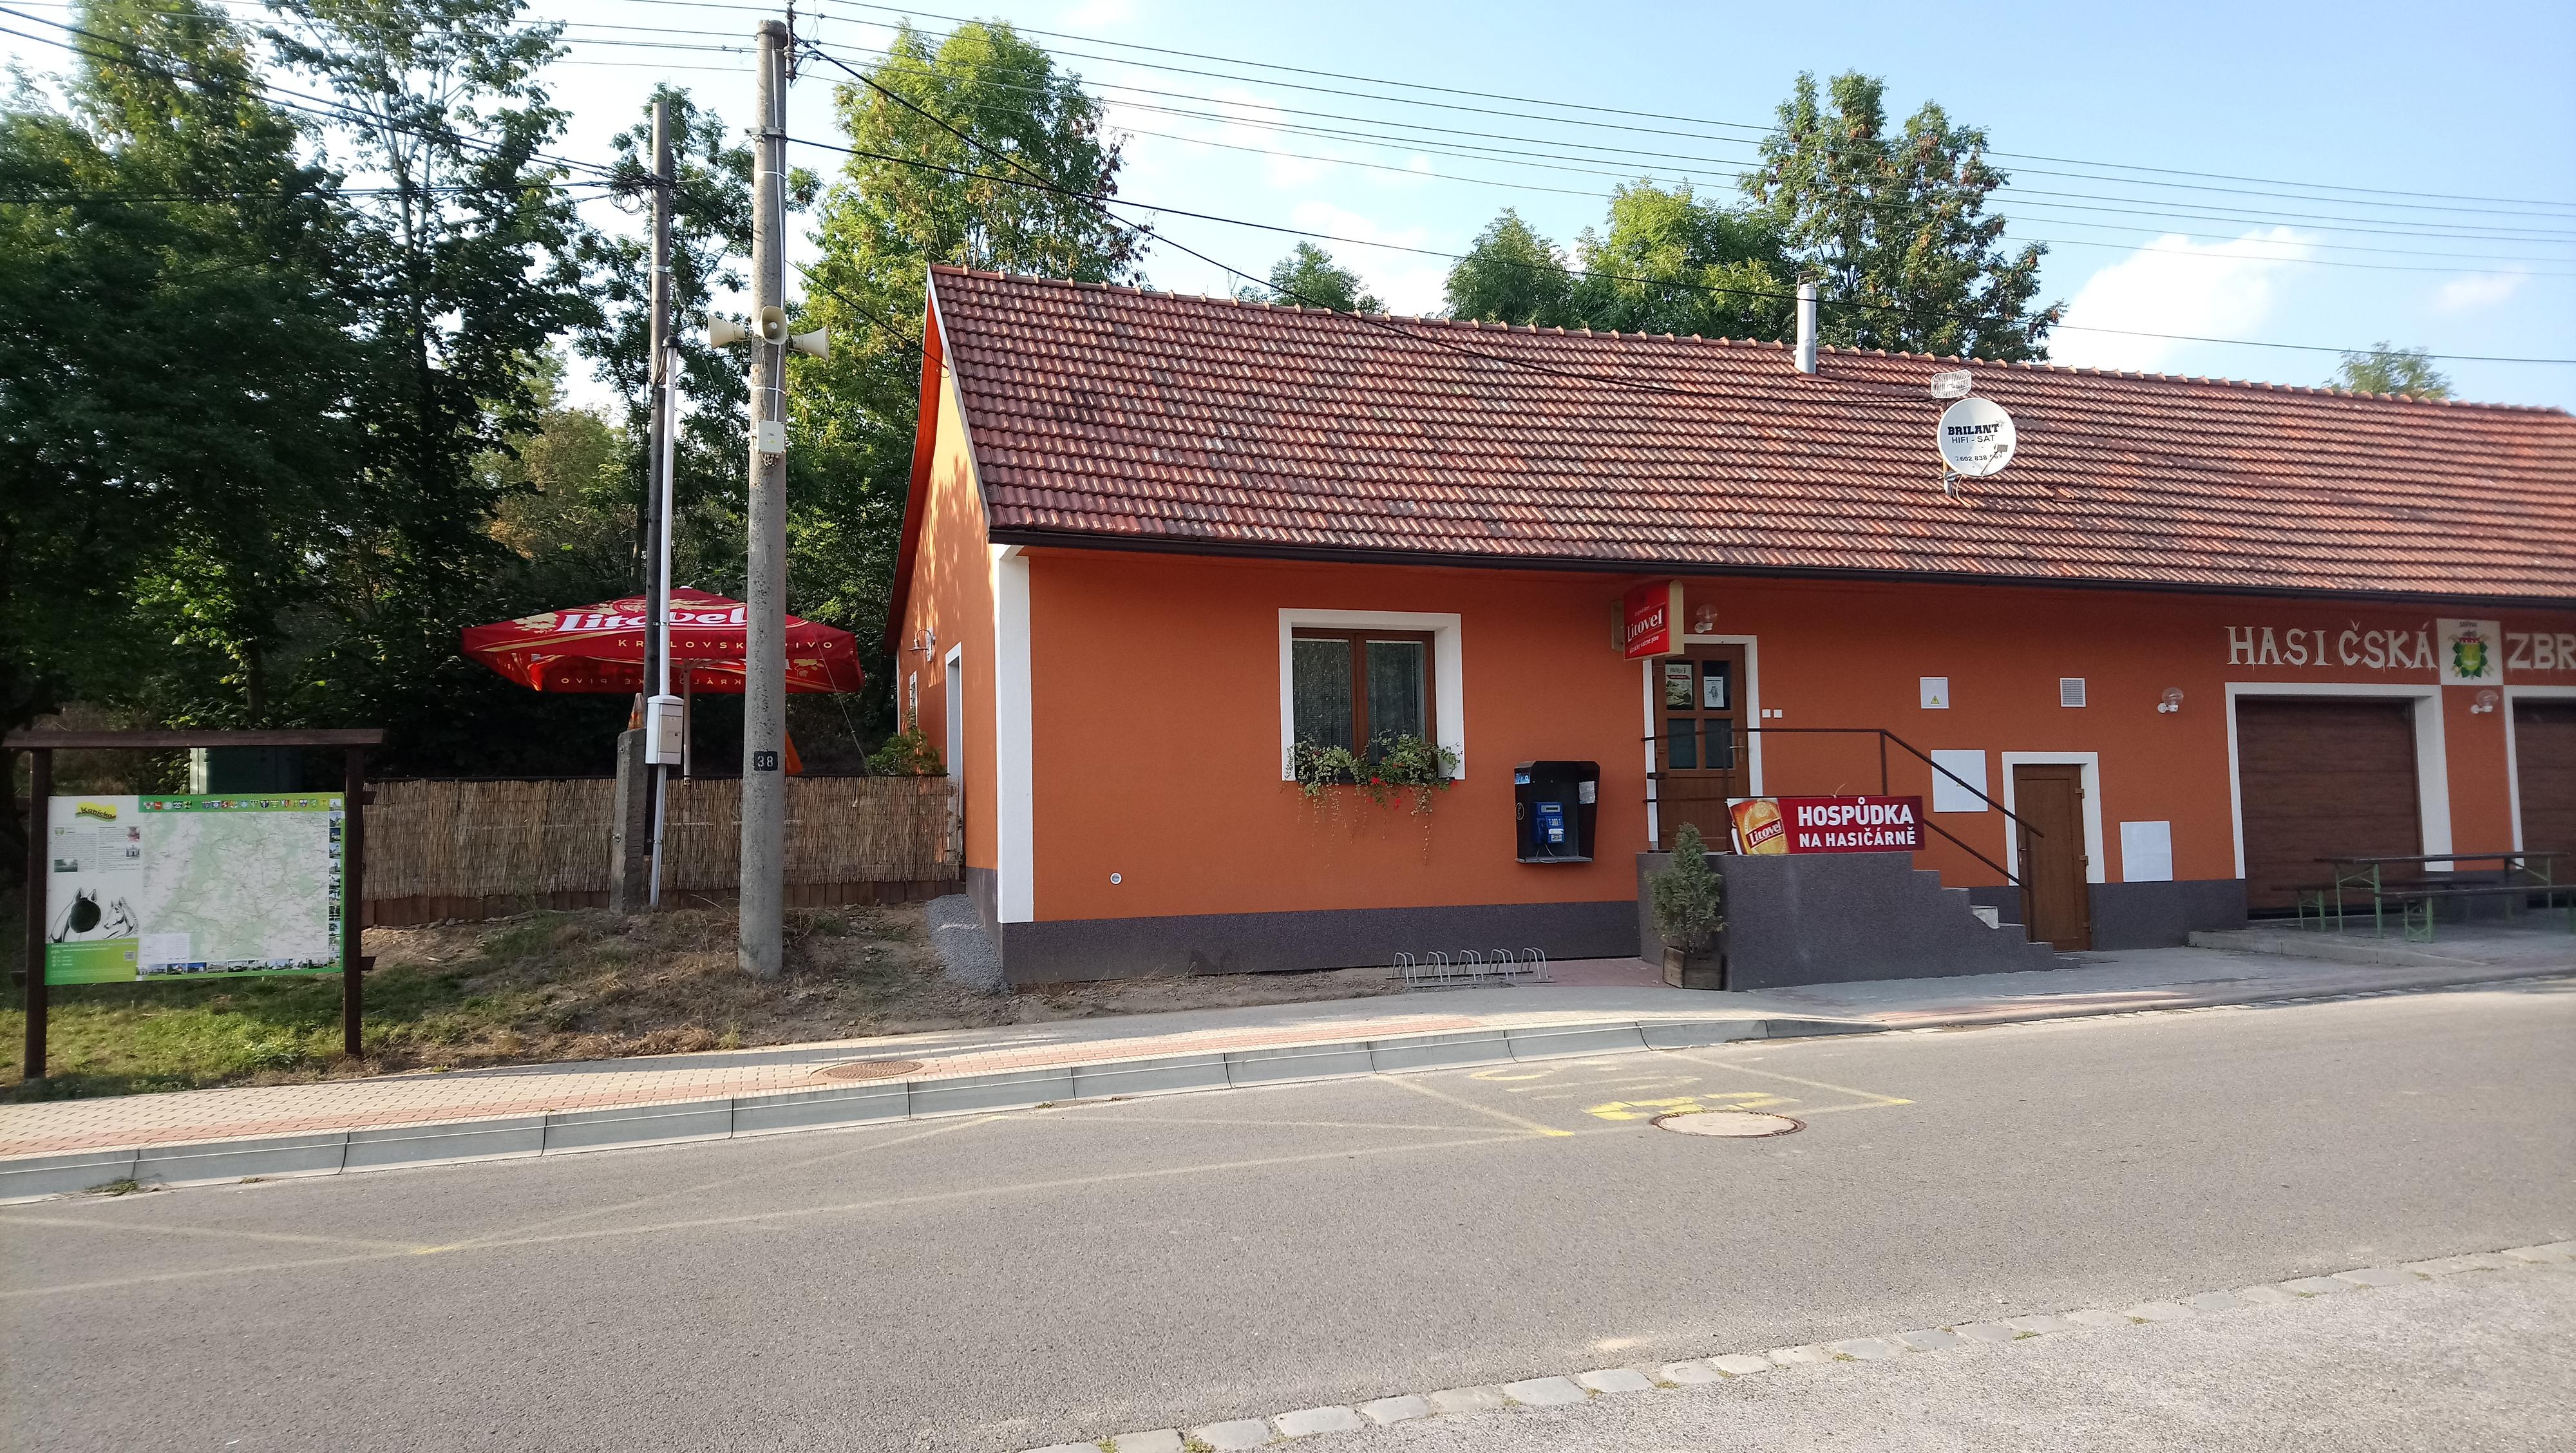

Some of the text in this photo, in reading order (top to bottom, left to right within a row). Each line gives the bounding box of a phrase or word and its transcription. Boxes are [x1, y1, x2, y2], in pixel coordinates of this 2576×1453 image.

[1947, 424, 2000, 435] BRILANT
[1627, 608, 1662, 642] Litovel
[618, 640, 744, 649] KRLOVSK
[2224, 619, 2576, 669] HASIČSKÁ ZBR
[757, 755, 773, 767] 38
[1797, 797, 1915, 826] HOSPŮDKA
[1748, 821, 1782, 846] Litovel
[1799, 827, 1917, 848] NA HASIČÁRNĚ
